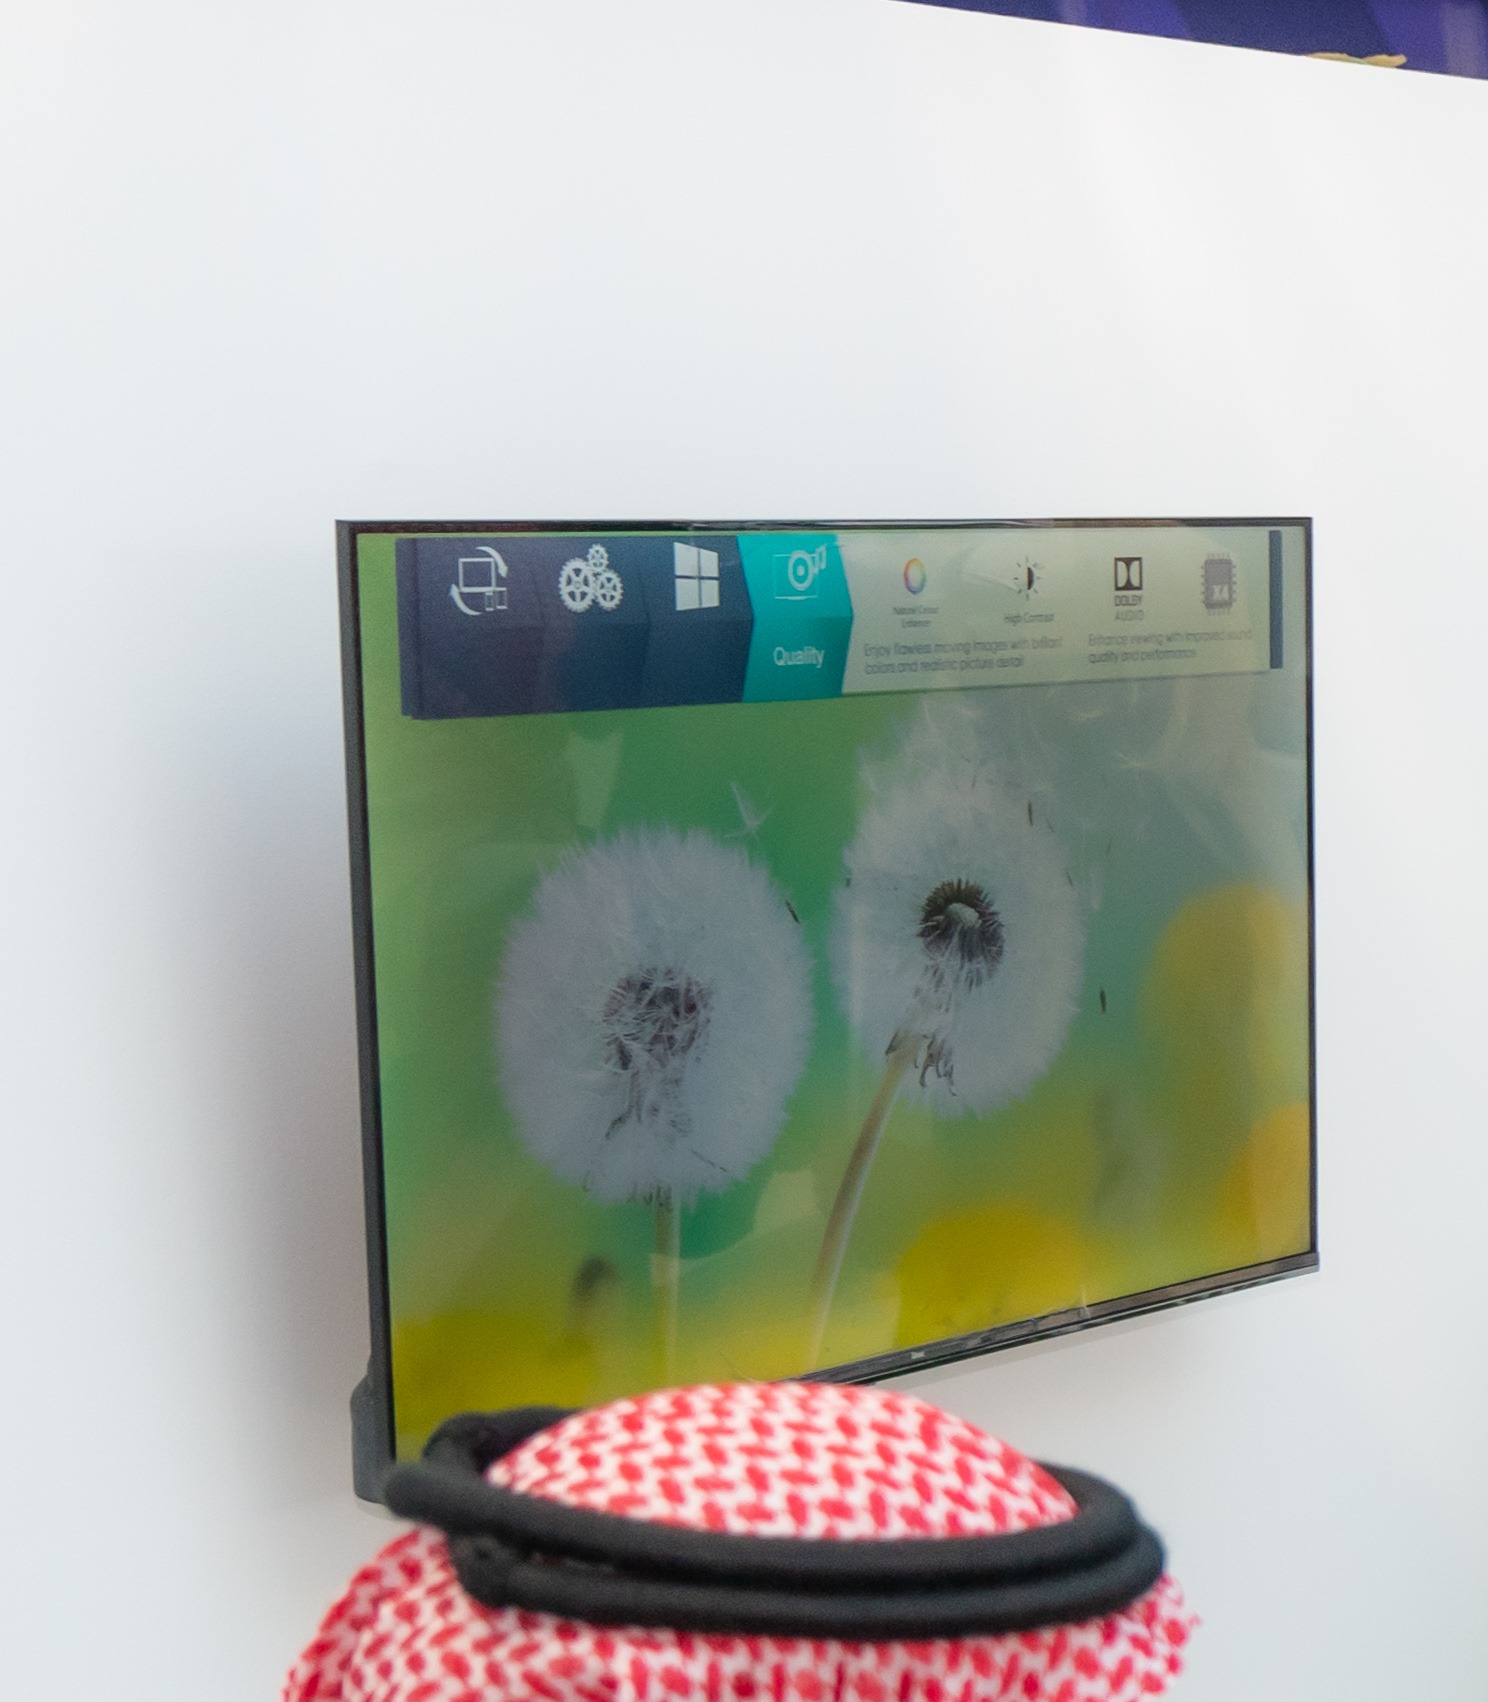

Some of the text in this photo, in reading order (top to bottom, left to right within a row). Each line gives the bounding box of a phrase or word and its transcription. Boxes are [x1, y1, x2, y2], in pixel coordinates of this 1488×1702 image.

[773, 645, 824, 668] Quality
[864, 643, 892, 658] Enjoy
[934, 642, 971, 655] moving
[973, 640, 1008, 653] images
[1120, 650, 1140, 662] and
[897, 661, 918, 672] and
